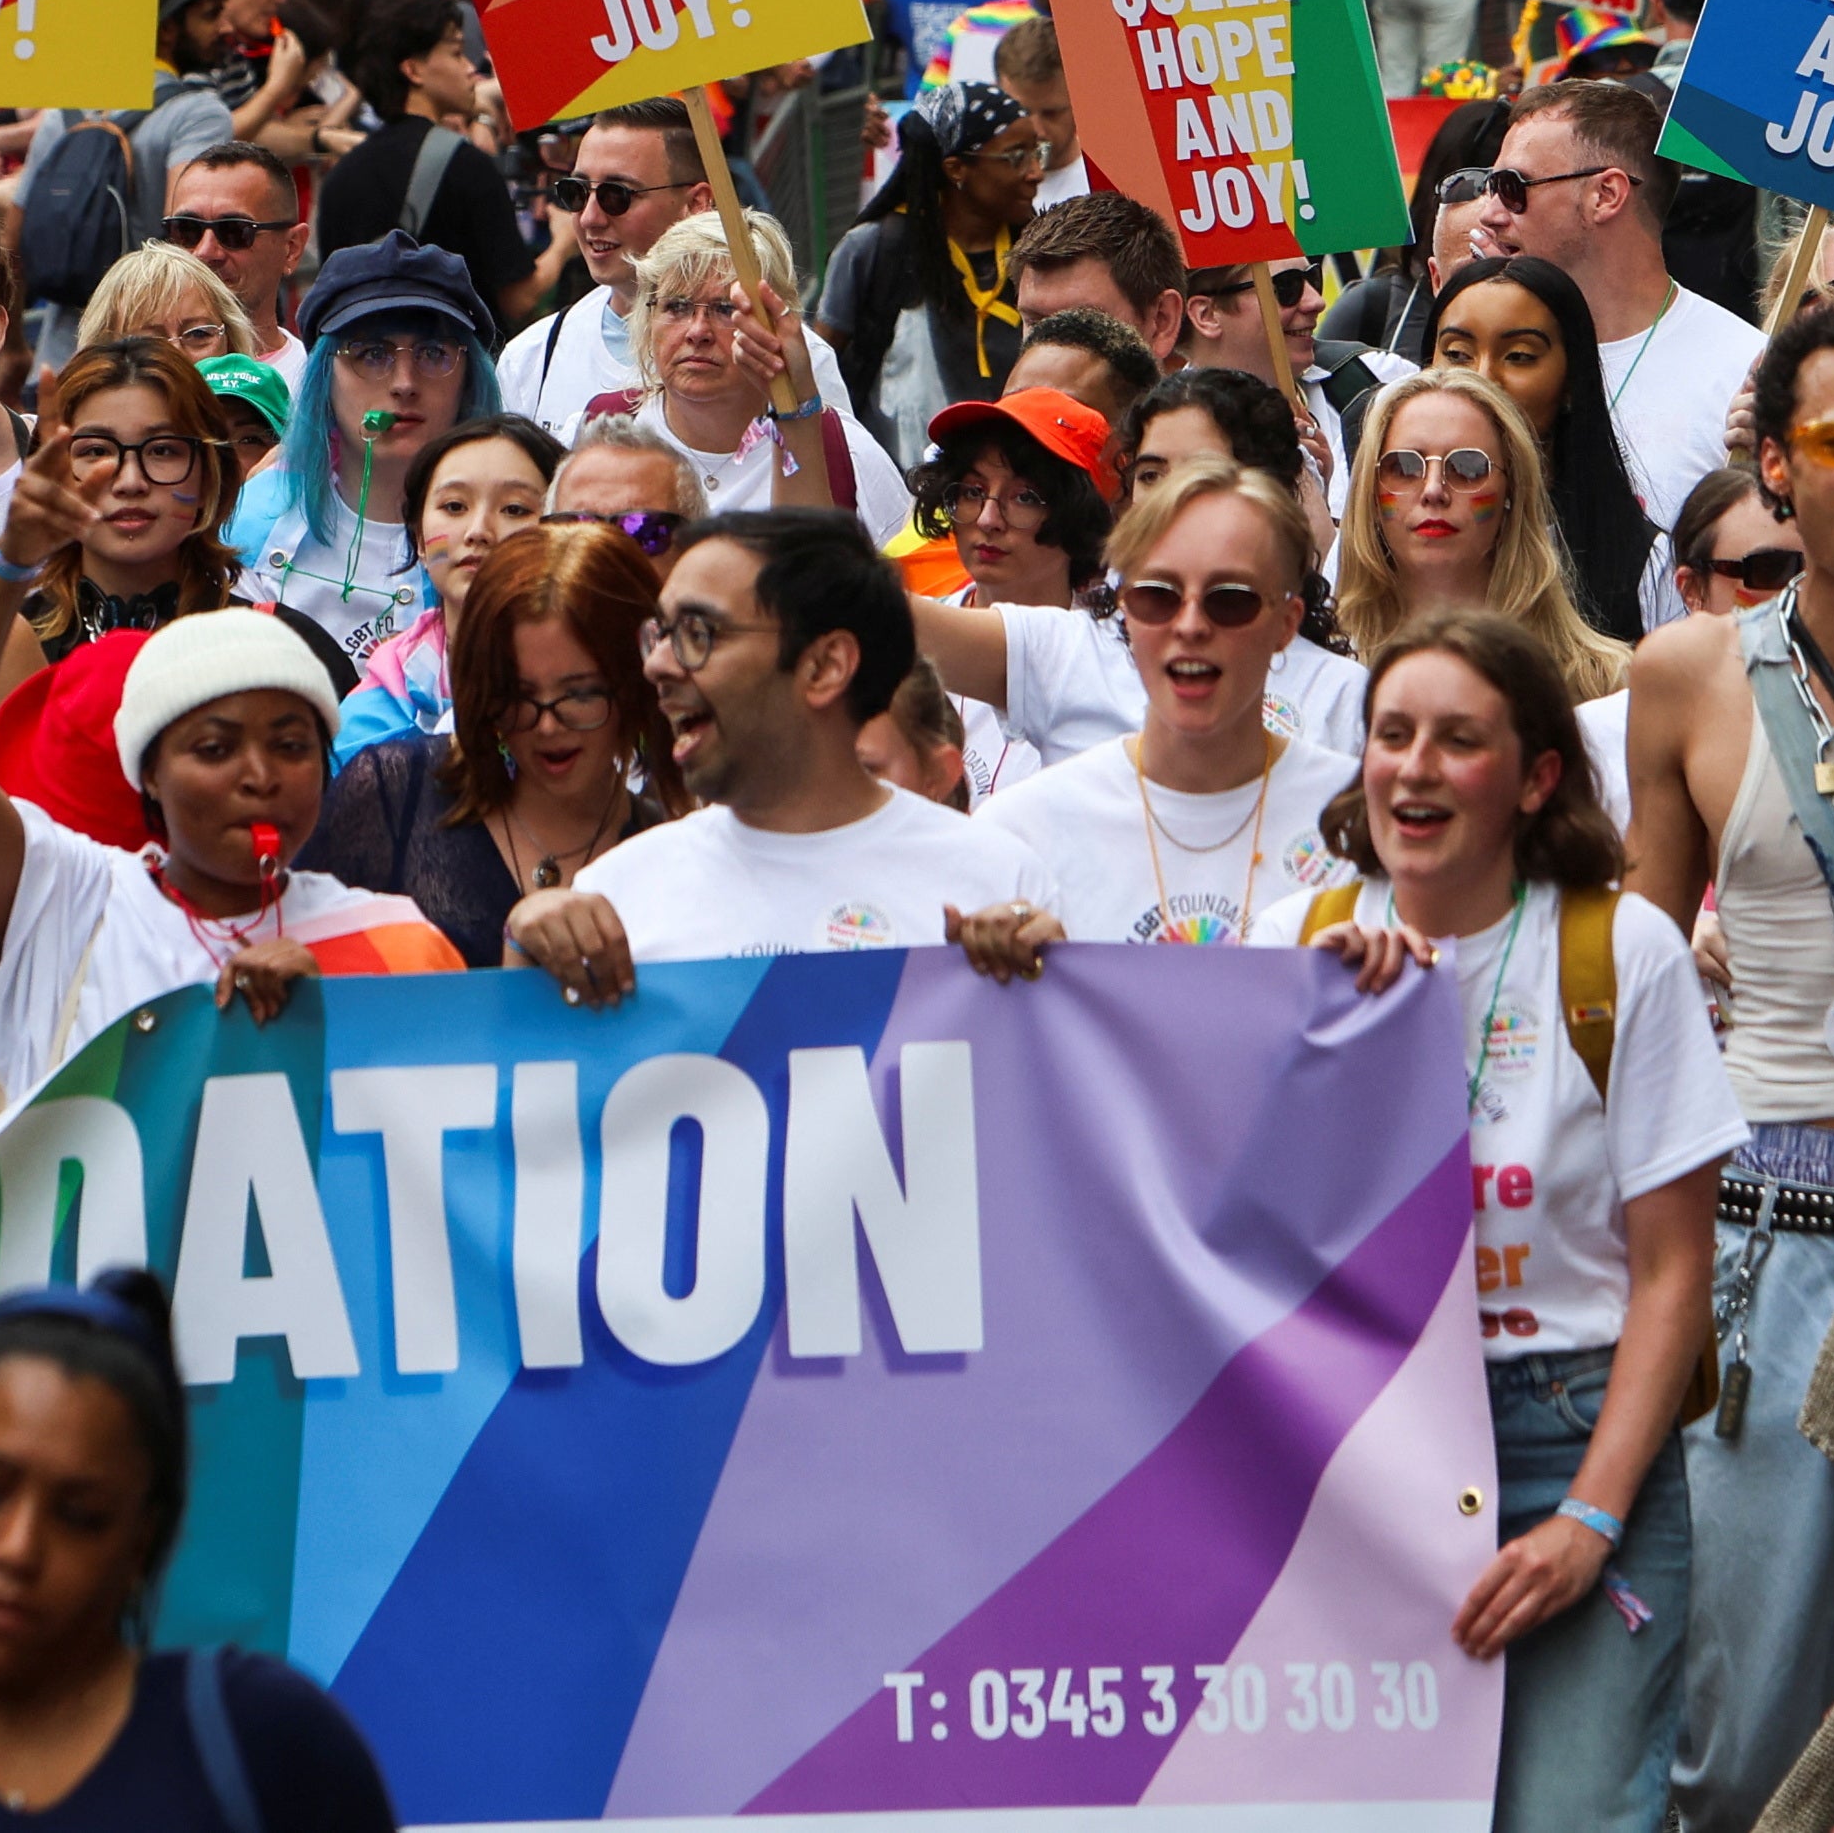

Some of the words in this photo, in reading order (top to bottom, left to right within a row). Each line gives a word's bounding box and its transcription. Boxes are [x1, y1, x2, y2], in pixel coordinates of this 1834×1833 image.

[1136, 15, 1295, 90] HOPE
[1176, 90, 1293, 161] AND
[1180, 159, 1316, 233] JOY!
[206, 372, 230, 381] NEW
[233, 372, 261, 384] YORK
[883, 1672, 949, 1743] T:
[969, 1667, 1125, 1741] 0345
[1140, 1664, 1177, 1739] 3
[1197, 1663, 1267, 1735] 30
[1287, 1661, 1355, 1733] 30
[1373, 1660, 1440, 1730] 30
